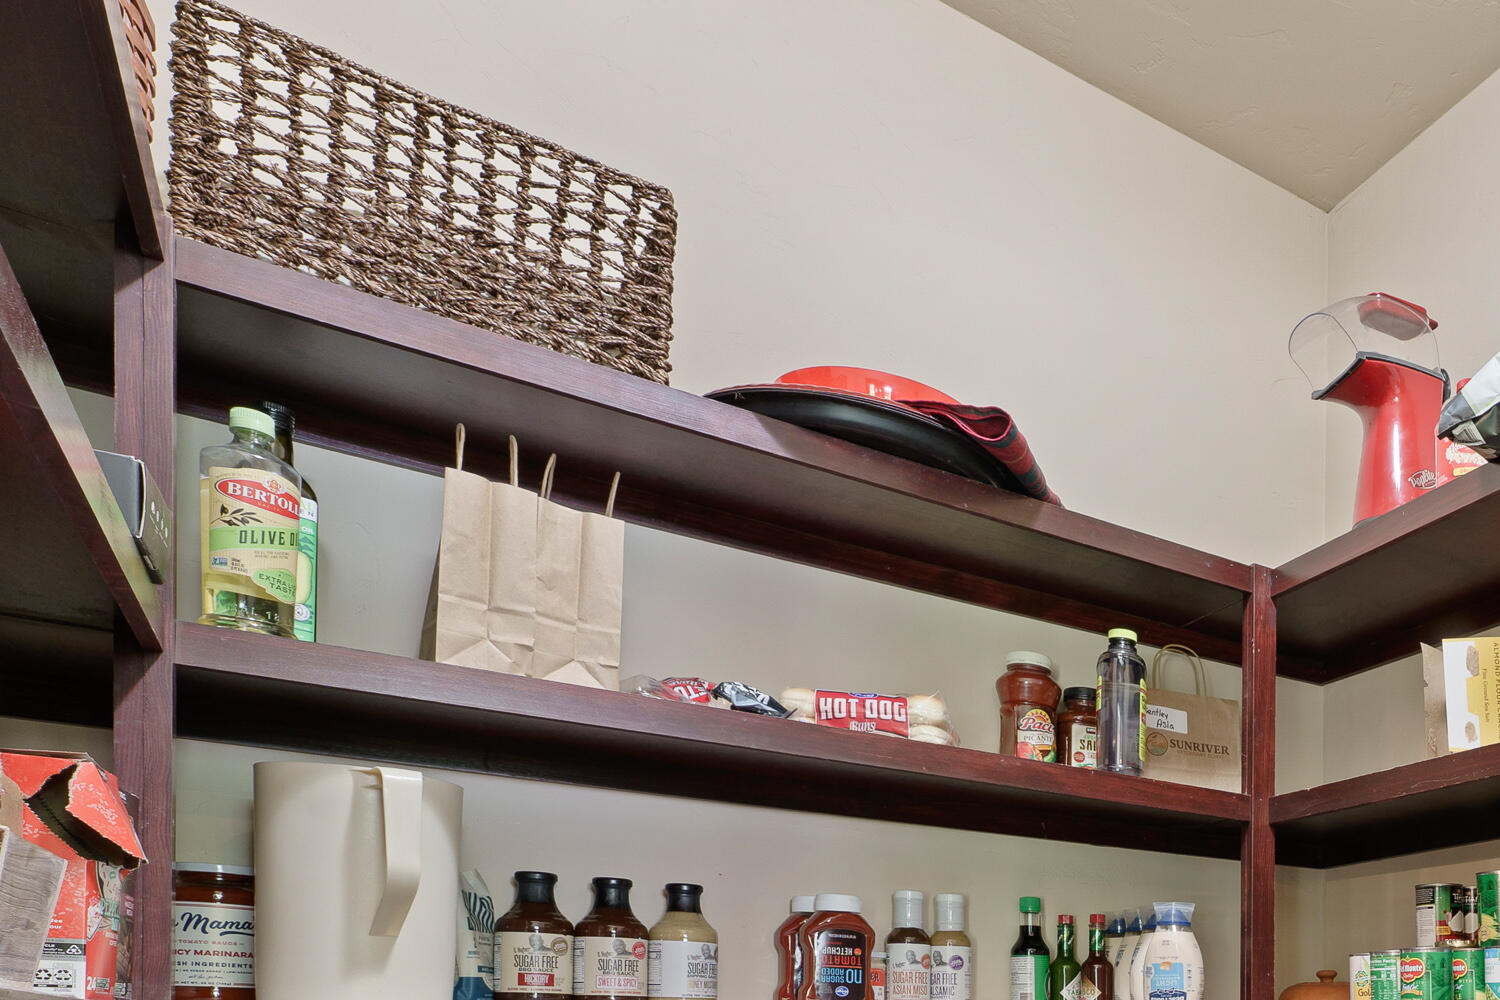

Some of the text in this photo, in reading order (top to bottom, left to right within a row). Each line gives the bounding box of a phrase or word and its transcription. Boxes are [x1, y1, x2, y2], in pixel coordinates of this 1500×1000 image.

[239, 529, 285, 547] OLIVE
[1493, 642, 1500, 679] ALMOND
[819, 697, 907, 723] HOT DOG
[1169, 738, 1230, 756] SUNRIVER
[193, 949, 254, 959] MARINARA
[822, 947, 853, 956] KETCHUP
[513, 954, 559, 969] SUGAR FREE
[597, 958, 640, 973] SUGAR FREE
[821, 967, 844, 976] ADDED
[892, 972, 929, 985] SUGAR FREE
[892, 984, 928, 996] ASIAN MISO
